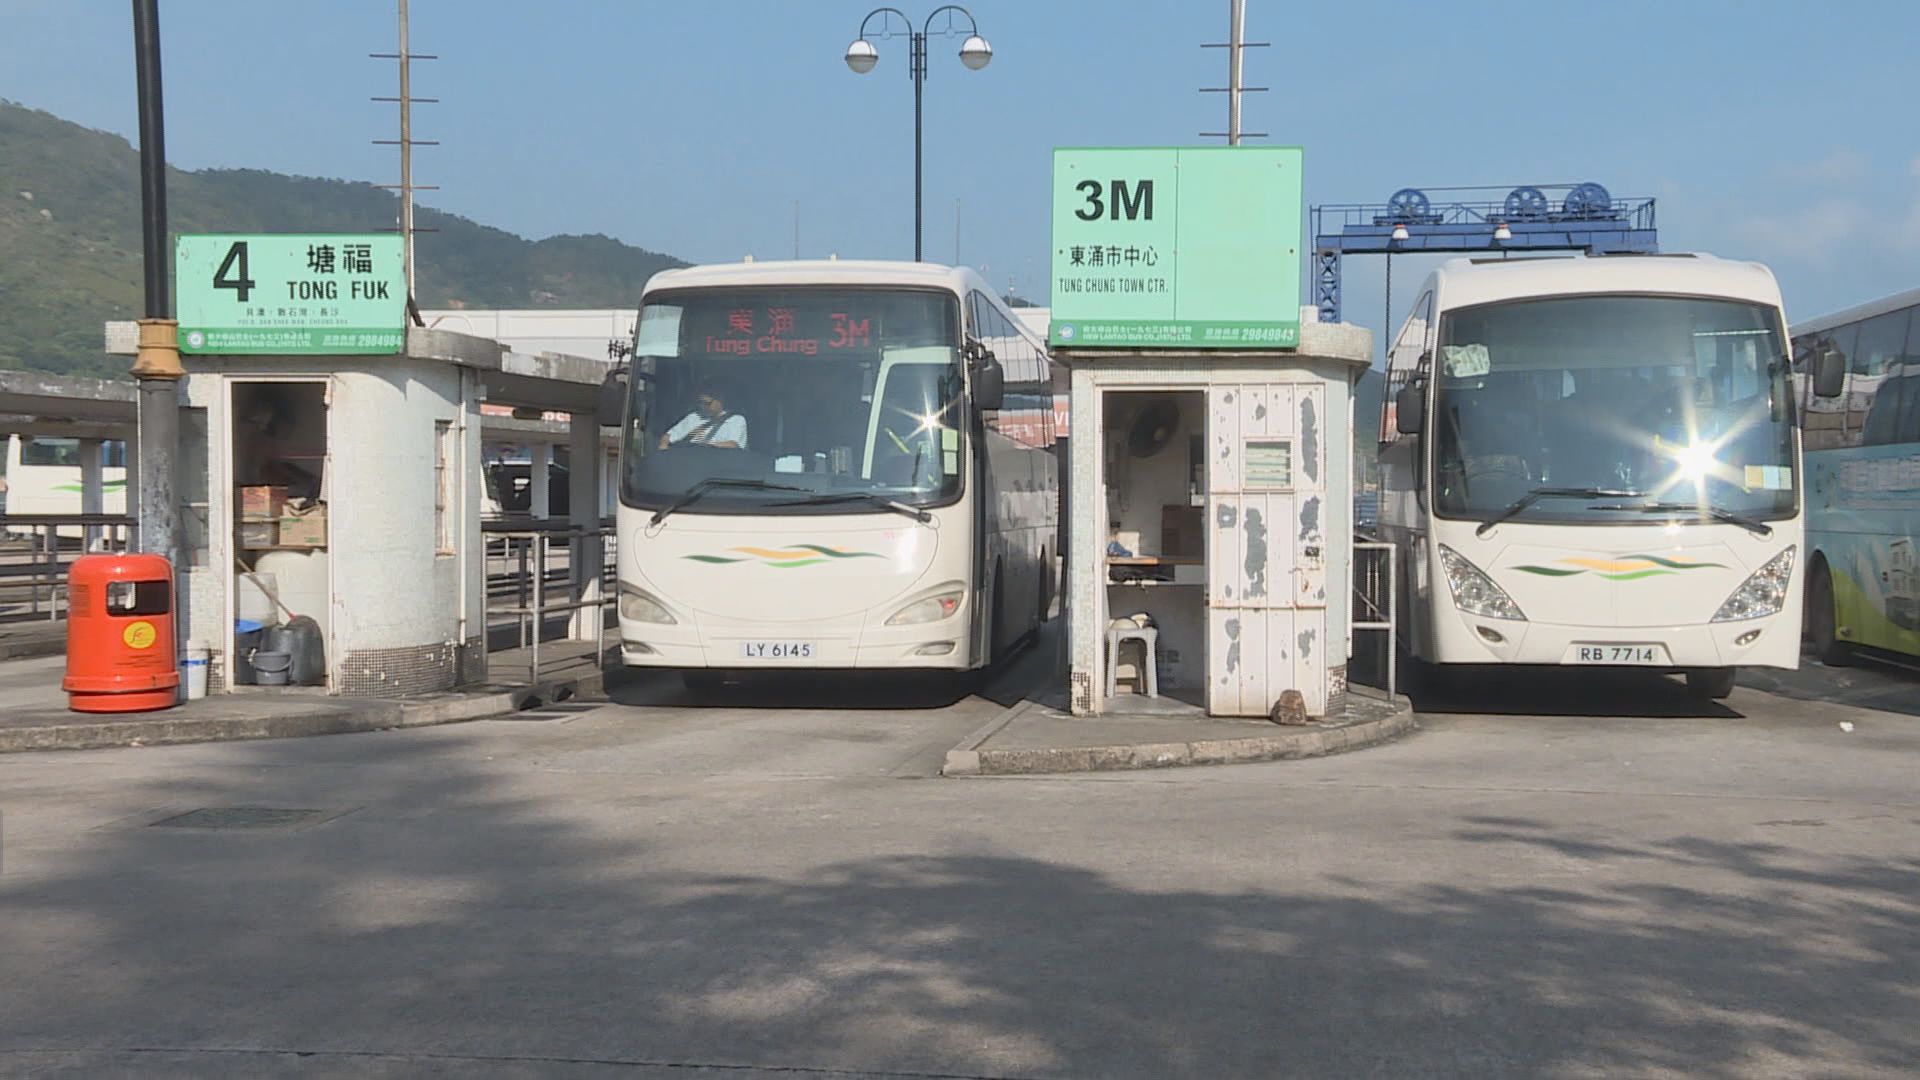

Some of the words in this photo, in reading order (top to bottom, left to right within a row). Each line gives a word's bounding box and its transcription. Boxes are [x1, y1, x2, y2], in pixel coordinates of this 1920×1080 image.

[1075, 180, 1153, 221] 3M
[307, 244, 372, 274] 塘福
[1070, 245, 1158, 267] 東涌市中心
[213, 241, 255, 302] 4
[287, 281, 337, 300] TONG
[351, 281, 389, 300] FUK
[1060, 278, 1082, 292] TUNG
[1086, 278, 1115, 292] CHUNG
[1120, 278, 1144, 292] TOWN
[1148, 278, 1168, 292] CTR.
[829, 313, 869, 348] 3M
[756, 336, 817, 355] Chung
[746, 643, 765, 656] LY
[772, 643, 810, 657] 6145
[1581, 647, 1603, 660] RB
[1611, 647, 1653, 661] 7714
